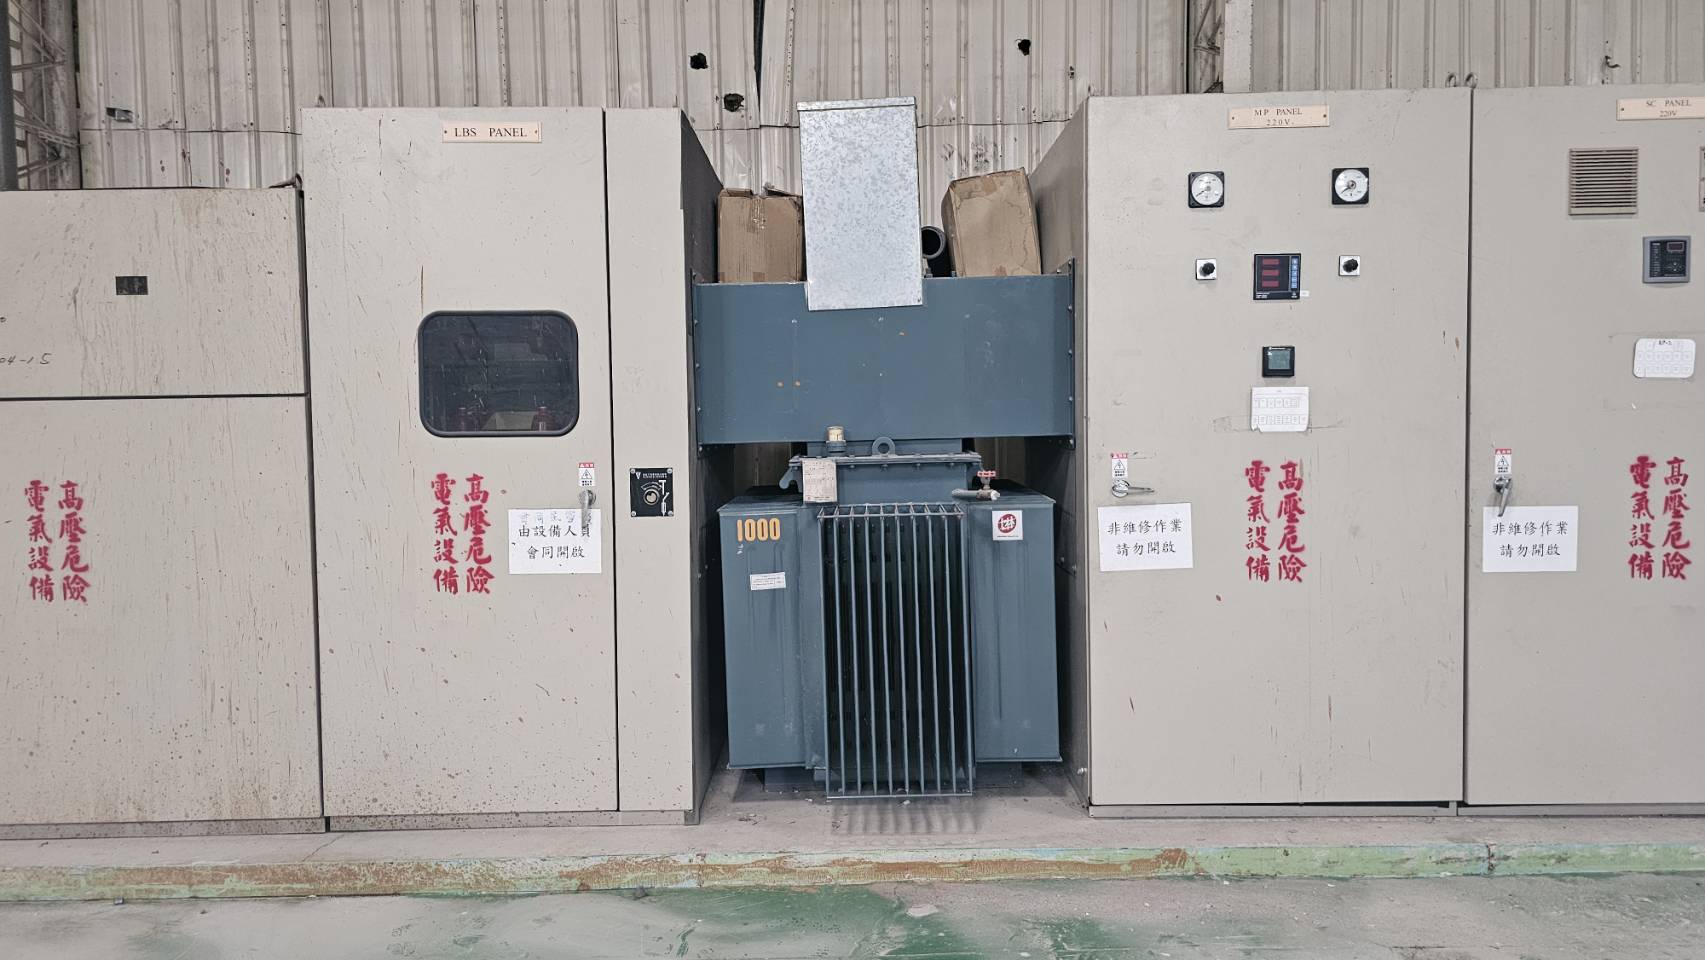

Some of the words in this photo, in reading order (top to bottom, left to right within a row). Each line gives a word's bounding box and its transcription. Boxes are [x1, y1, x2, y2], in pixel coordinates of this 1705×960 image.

[454, 127, 477, 137] LBS
[489, 127, 527, 137] PANEL
[1276, 107, 1303, 117] PANEL
[1646, 99, 1657, 107] SC
[1664, 98, 1692, 107] PANEL
[1659, 109, 1678, 118] 220V
[24, 480, 54, 602] 電氣設備
[58, 480, 91, 602] 高壓危險
[431, 473, 459, 595] 電氣設備
[464, 473, 494, 594] 高壓危險
[737, 517, 781, 542] 1000
[1107, 518, 1182, 536] 非維修作業
[1245, 460, 1271, 582] 電氣設備
[1278, 460, 1307, 582] 高壓危險
[1492, 520, 1568, 537] 非維修作業
[1628, 456, 1656, 580] 電氣設備
[1662, 457, 1692, 580] 高壓危險
